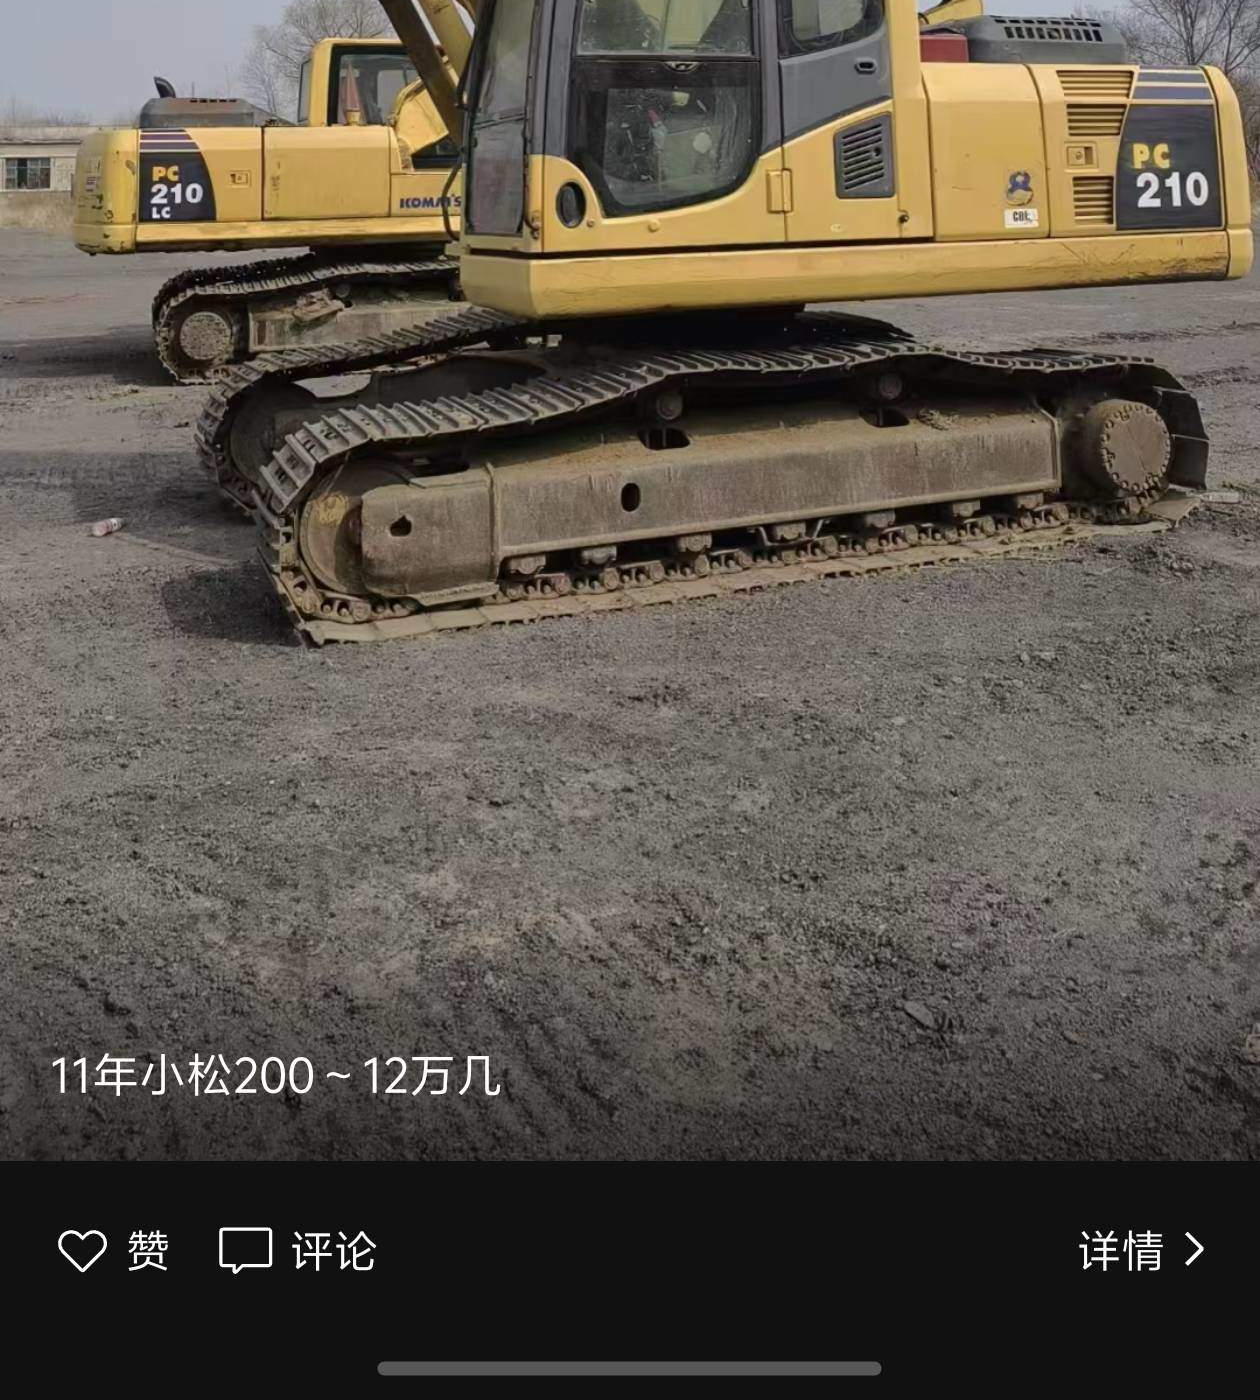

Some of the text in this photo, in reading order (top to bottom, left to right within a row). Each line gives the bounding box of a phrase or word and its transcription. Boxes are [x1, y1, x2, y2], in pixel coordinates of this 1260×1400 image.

[1133, 143, 1170, 169] PC
[152, 165, 179, 181] PC
[150, 183, 203, 204] 210
[1136, 171, 1209, 208] 210
[152, 206, 171, 219] LC
